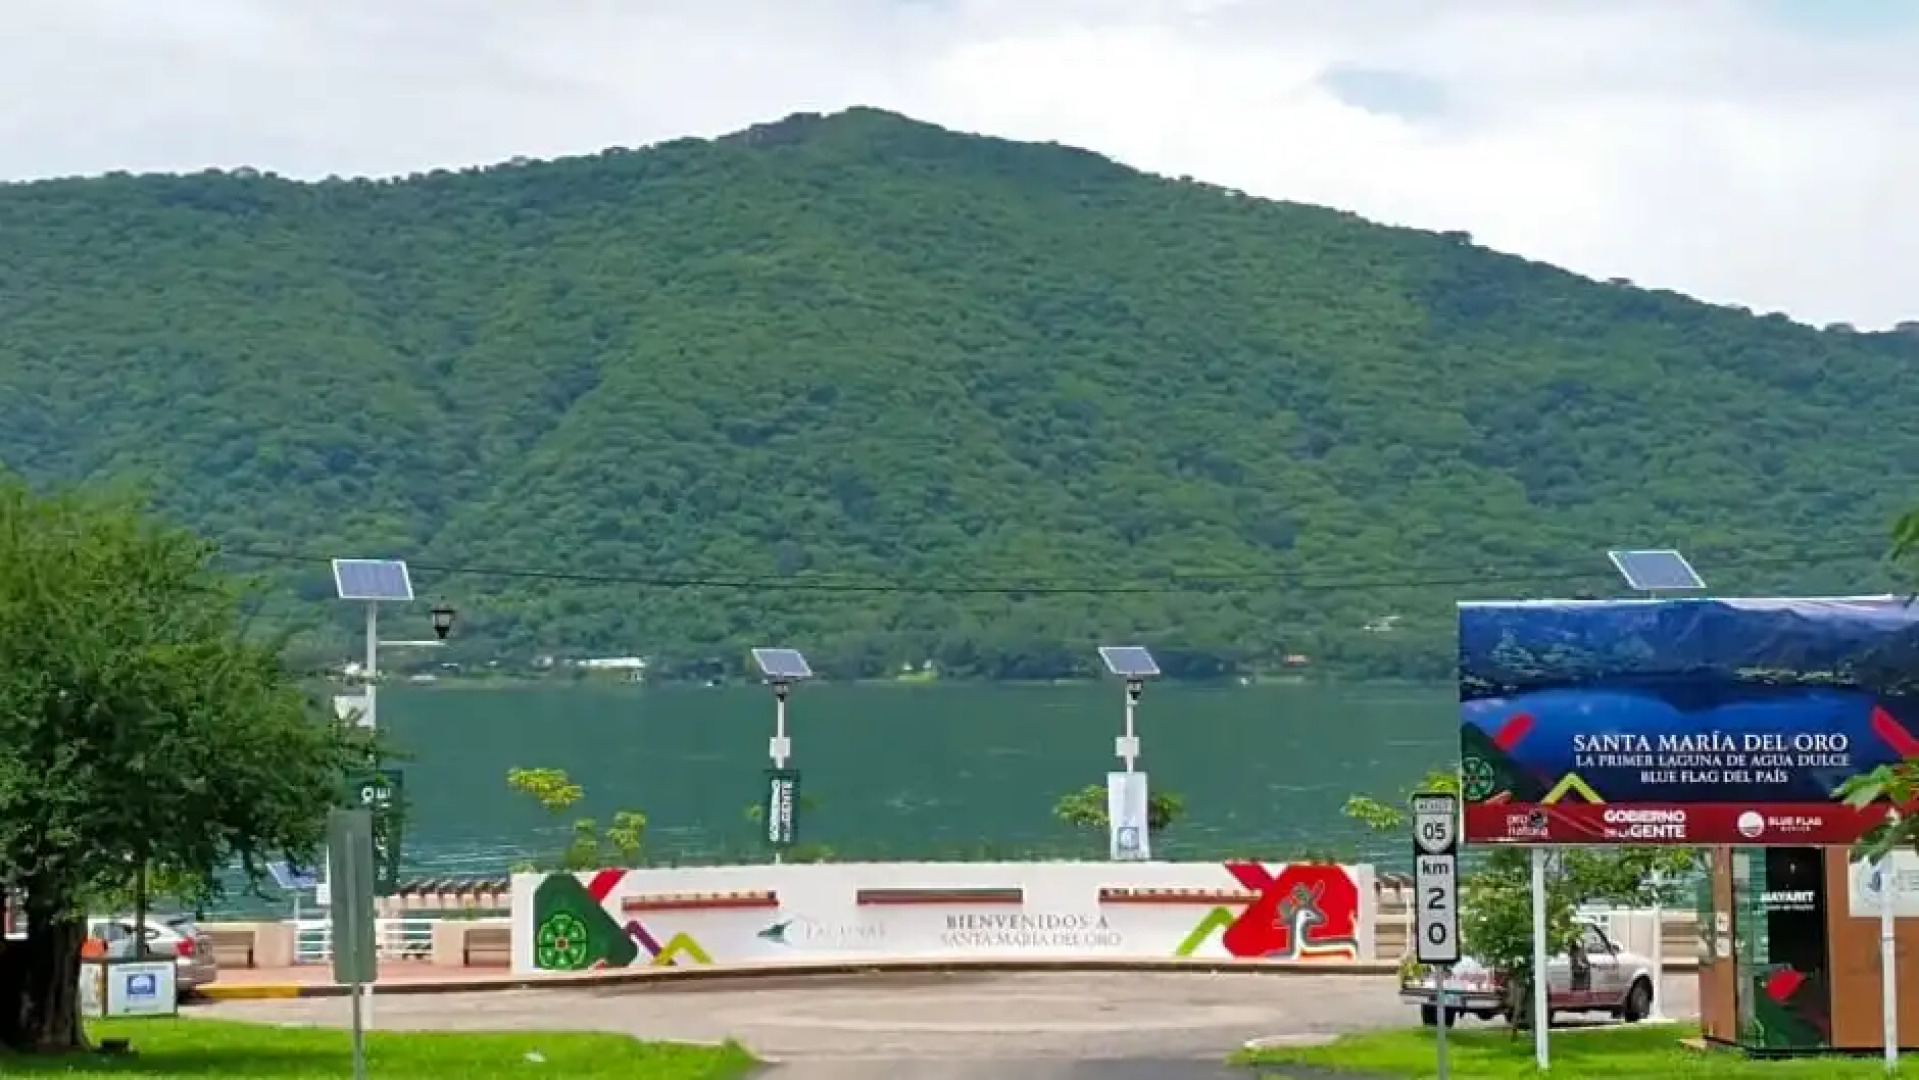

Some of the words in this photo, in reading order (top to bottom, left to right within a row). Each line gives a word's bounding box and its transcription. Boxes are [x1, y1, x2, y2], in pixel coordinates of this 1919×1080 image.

[1573, 734, 1651, 751] SANTA
[1658, 730, 1736, 751] MARÍA
[1744, 734, 1788, 751] DEL
[1794, 733, 1848, 751] ORO
[1575, 754, 1594, 767] LA
[1600, 754, 1653, 767] PRIMER
[1659, 754, 1721, 767] LAGUNA
[1726, 754, 1746, 767] DE
[1751, 754, 1794, 767] AGUA
[1798, 753, 1850, 767] DULCE
[1640, 771, 1678, 782] BLUE
[1681, 771, 1719, 782] FLAG
[1723, 770, 1753, 782] DEL
[1755, 768, 1788, 782] PAÍS
[1604, 810, 1686, 822] GOBIERNO
[1423, 822, 1446, 840] 05
[1630, 824, 1686, 838] GENTE
[1422, 860, 1449, 875] km
[946, 914, 1090, 930] BIENVENIDOS
[1096, 914, 1109, 930] A
[939, 931, 992, 947] SANTA
[1083, 931, 1122, 946] ORO
